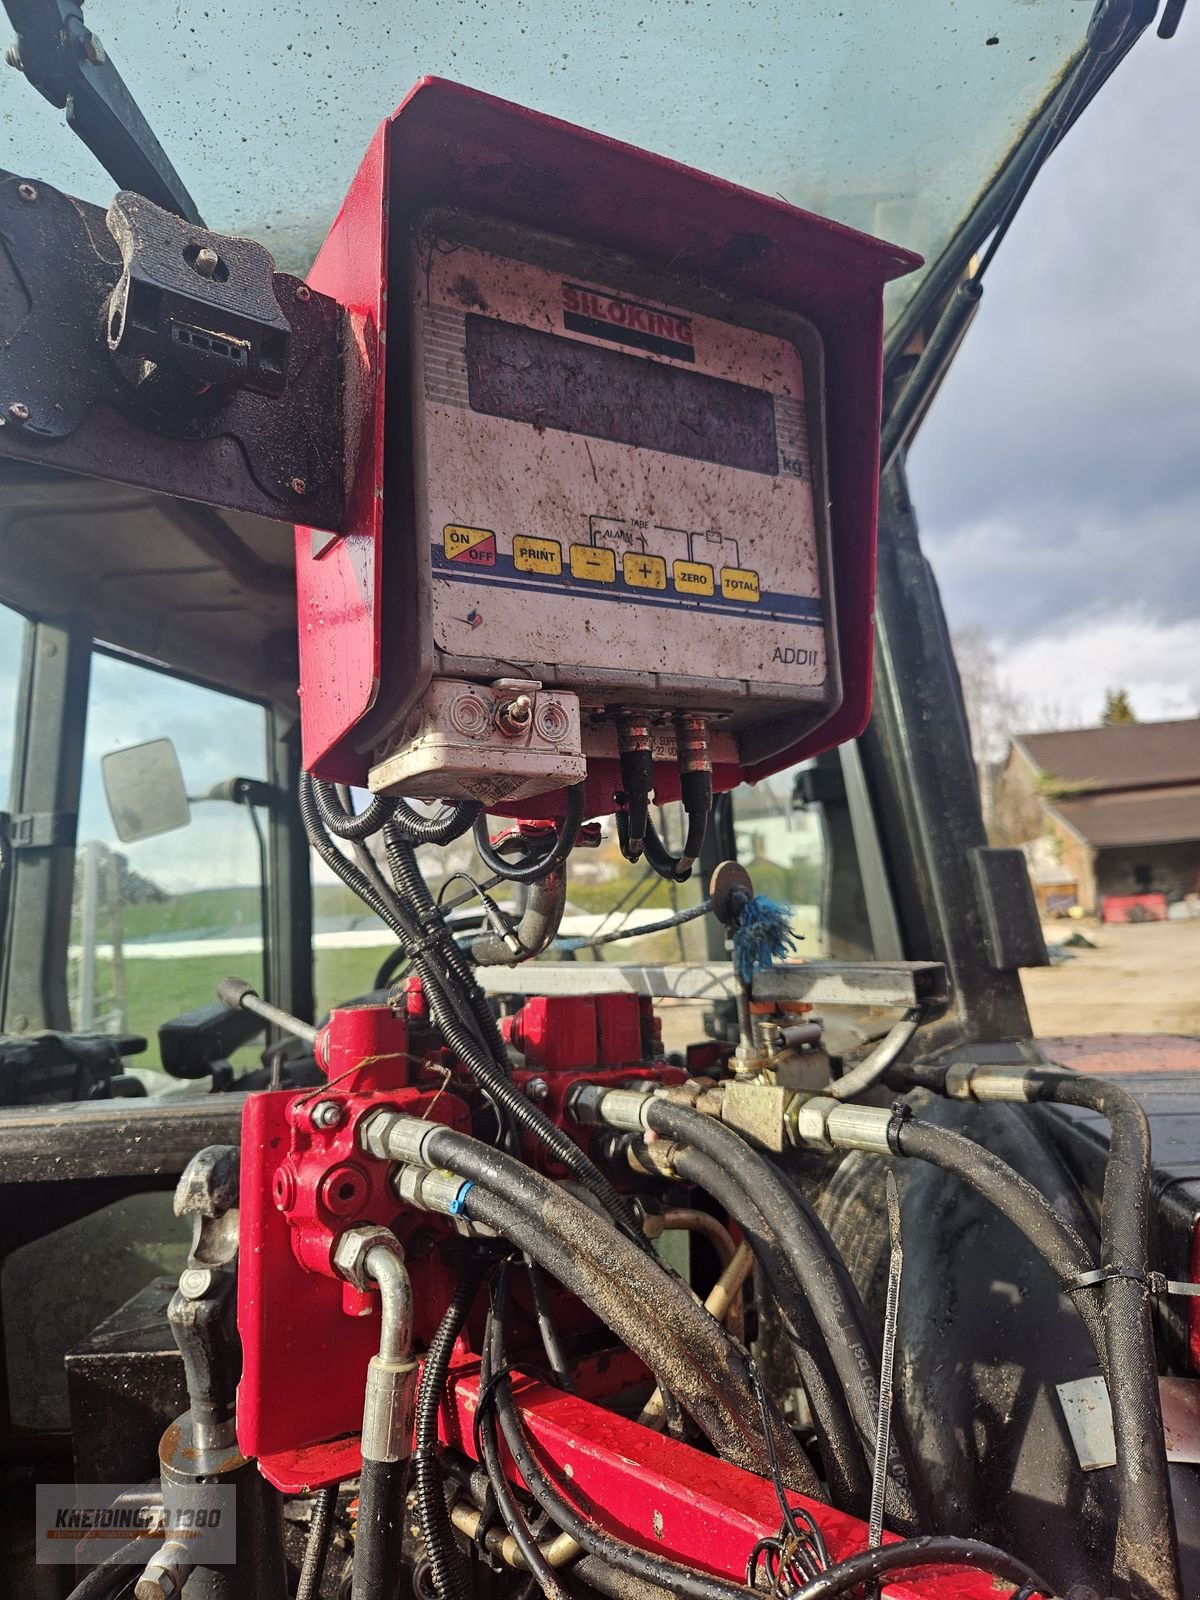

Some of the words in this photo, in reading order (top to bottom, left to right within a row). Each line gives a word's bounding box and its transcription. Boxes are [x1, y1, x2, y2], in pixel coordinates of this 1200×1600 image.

[562, 288, 694, 343] SILOKING
[783, 456, 802, 477] kg
[449, 532, 470, 544] ON
[469, 549, 493, 562] OFF
[520, 548, 555, 562] PRINT
[680, 572, 707, 585] ZERO
[724, 579, 756, 592] TOTAL
